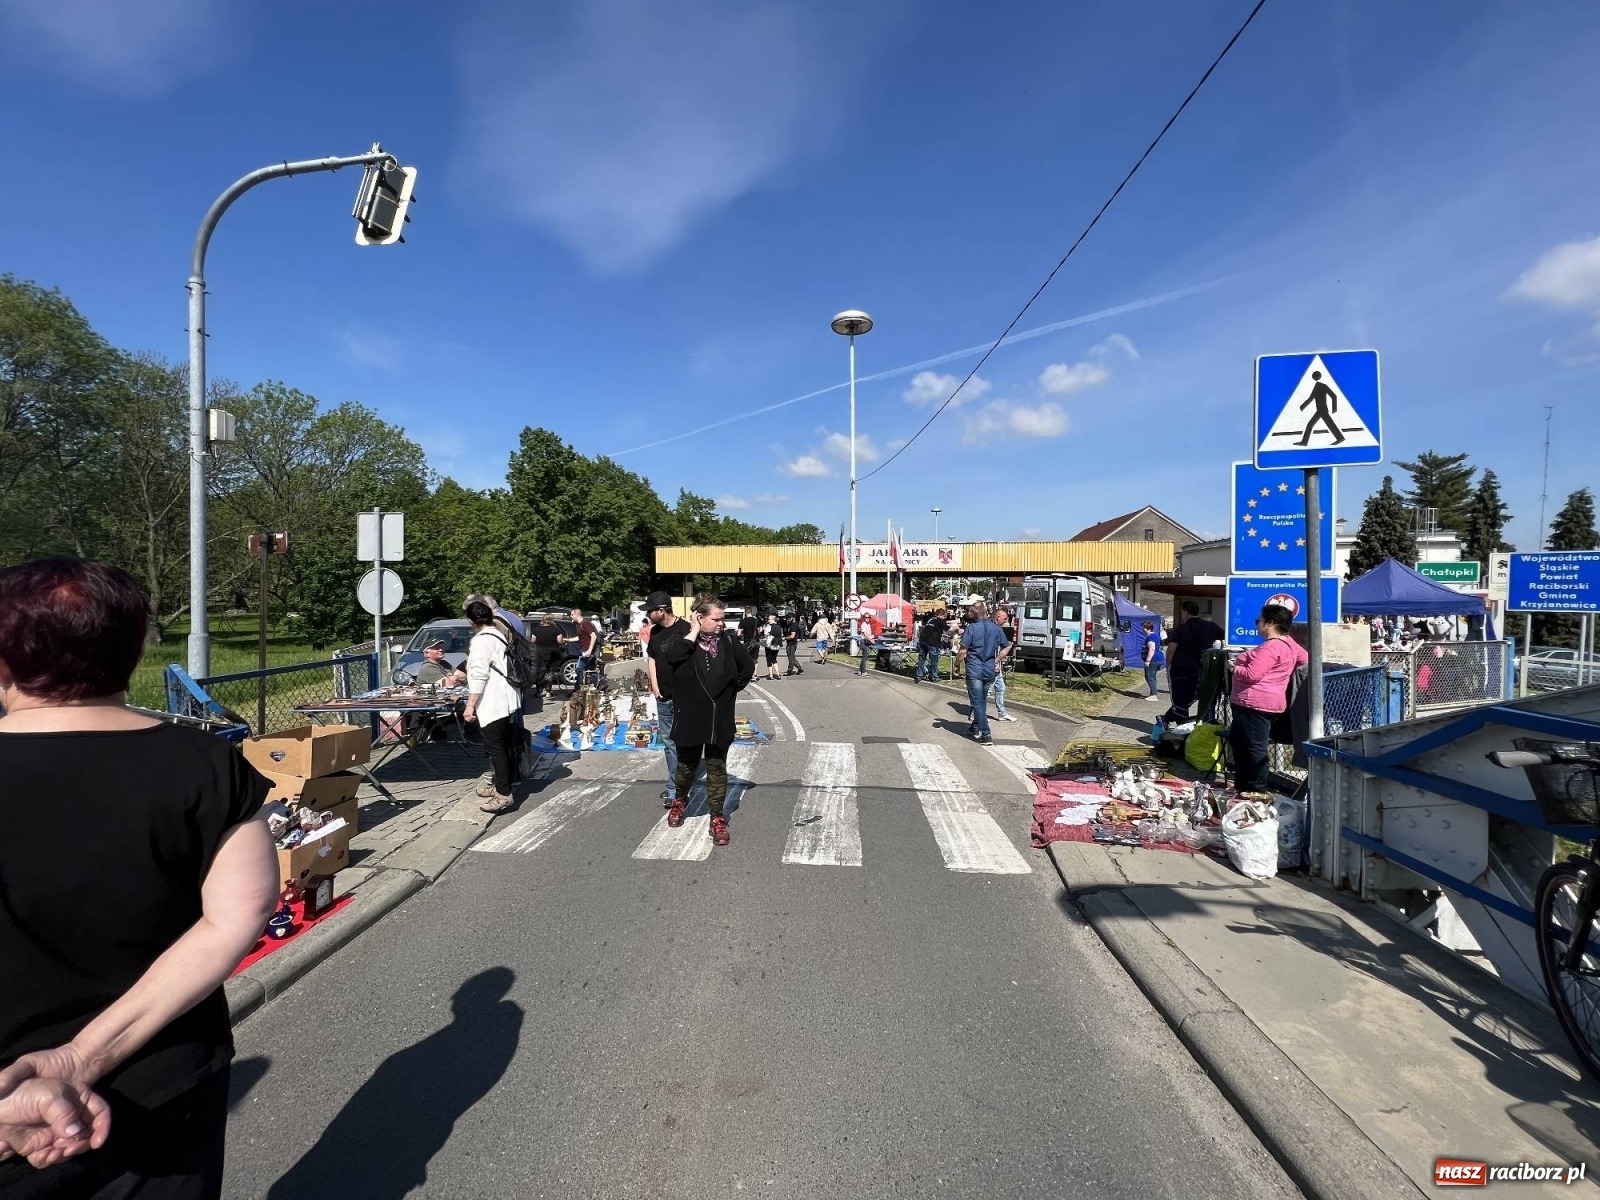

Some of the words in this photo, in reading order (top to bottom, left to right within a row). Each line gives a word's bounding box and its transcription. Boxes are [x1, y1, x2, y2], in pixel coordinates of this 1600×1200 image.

[869, 549, 929, 557] JAARK
[1520, 554, 1600, 563] Województwo
[1539, 562, 1580, 572] Śląskie
[1421, 568, 1474, 578] Chałupki
[1246, 582, 1296, 590] Rzeczpospolita
[1529, 582, 1590, 590] Raciborski
[1538, 591, 1577, 599] Gmina
[1520, 600, 1597, 609] Krzyżanowice
